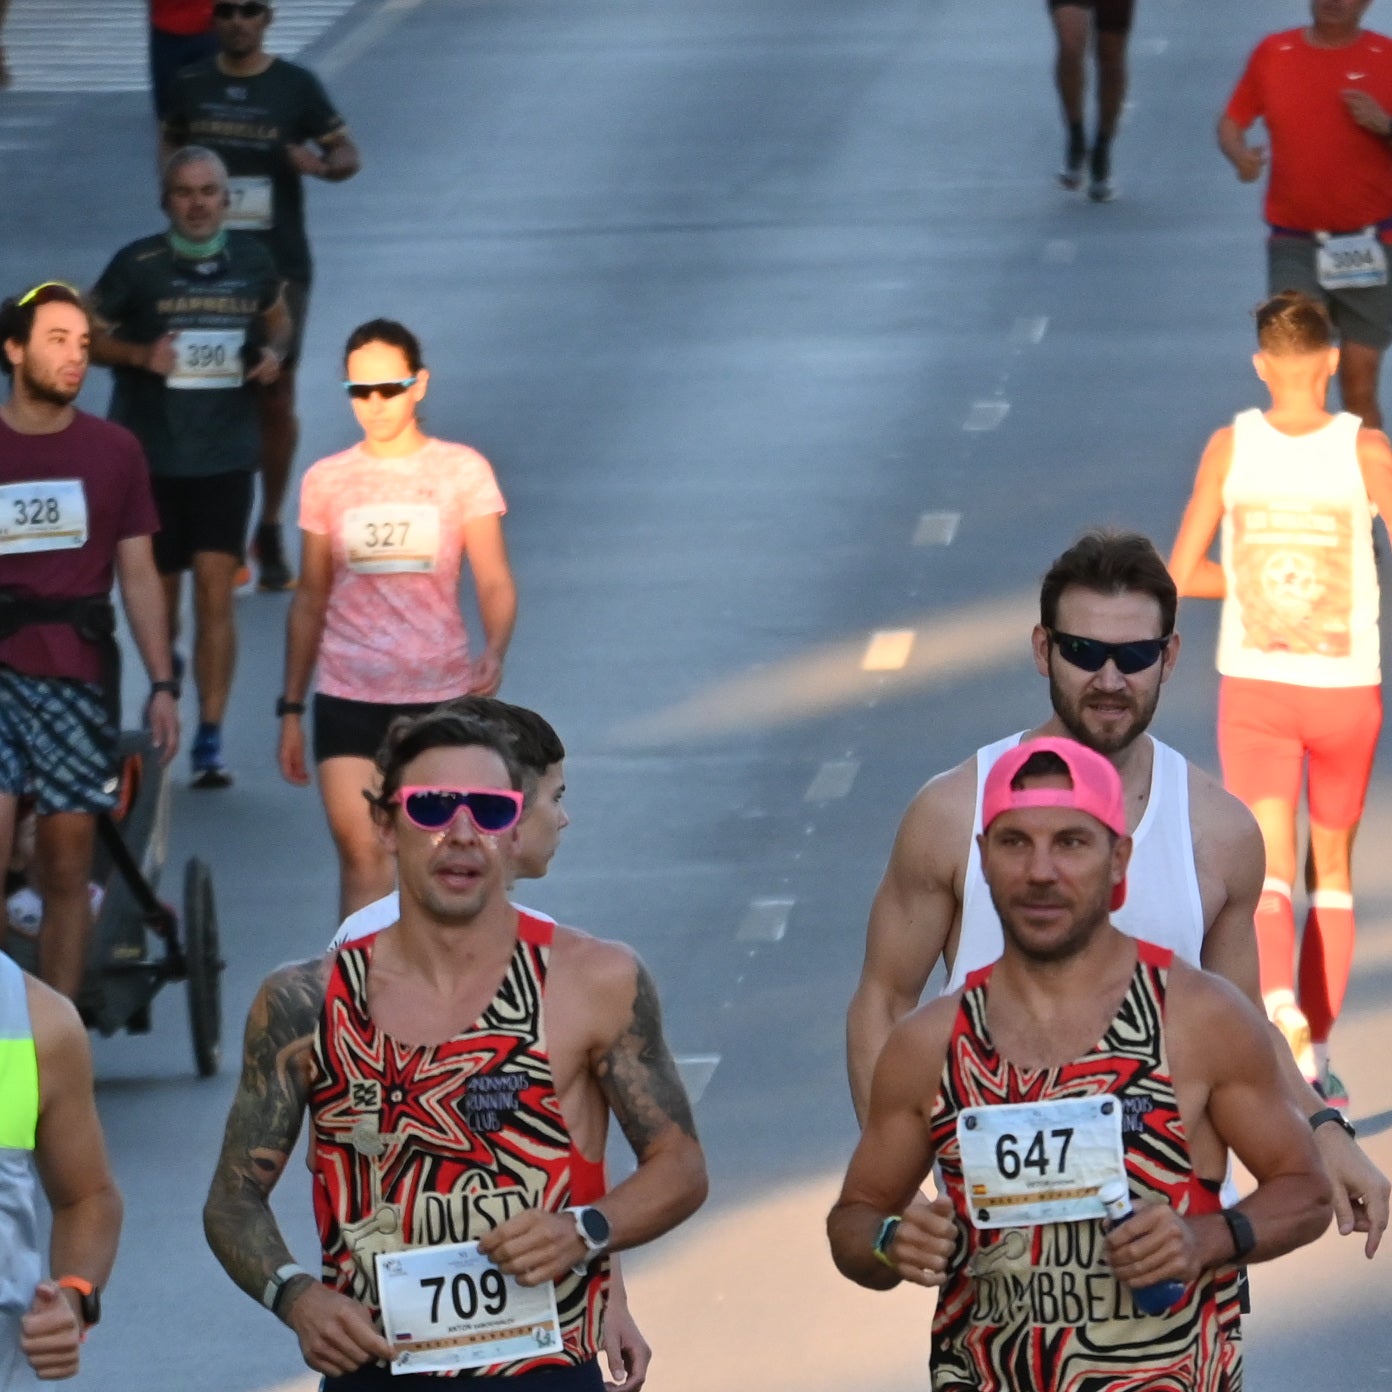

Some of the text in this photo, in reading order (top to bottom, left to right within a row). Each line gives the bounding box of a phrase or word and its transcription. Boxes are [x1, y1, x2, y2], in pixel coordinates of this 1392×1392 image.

[188, 344, 225, 367] 390
[14, 497, 60, 525] 328
[365, 522, 410, 548] 327
[467, 1074, 529, 1091] ANONYMOUS
[467, 1112, 501, 1131] CLUB
[995, 1128, 1074, 1180] 647
[420, 1268, 507, 1324] 709
